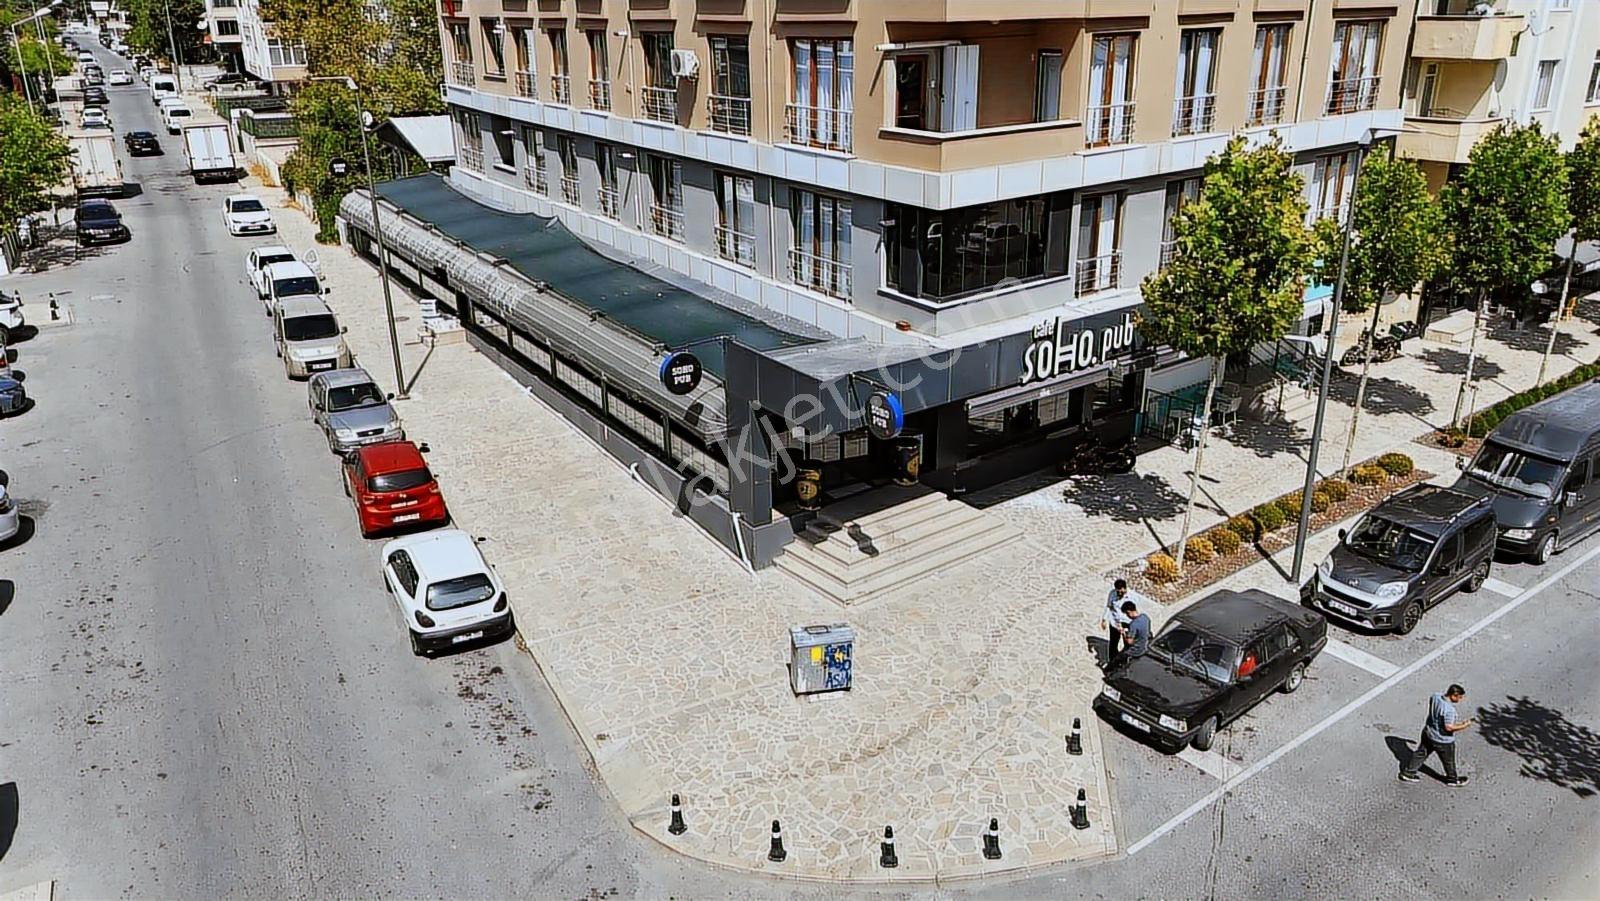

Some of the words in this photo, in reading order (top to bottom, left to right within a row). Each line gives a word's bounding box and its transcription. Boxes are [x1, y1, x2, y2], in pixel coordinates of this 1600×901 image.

[1101, 313, 1134, 362] pub
[671, 364, 694, 375] SOHO
[674, 374, 692, 385] PUB
